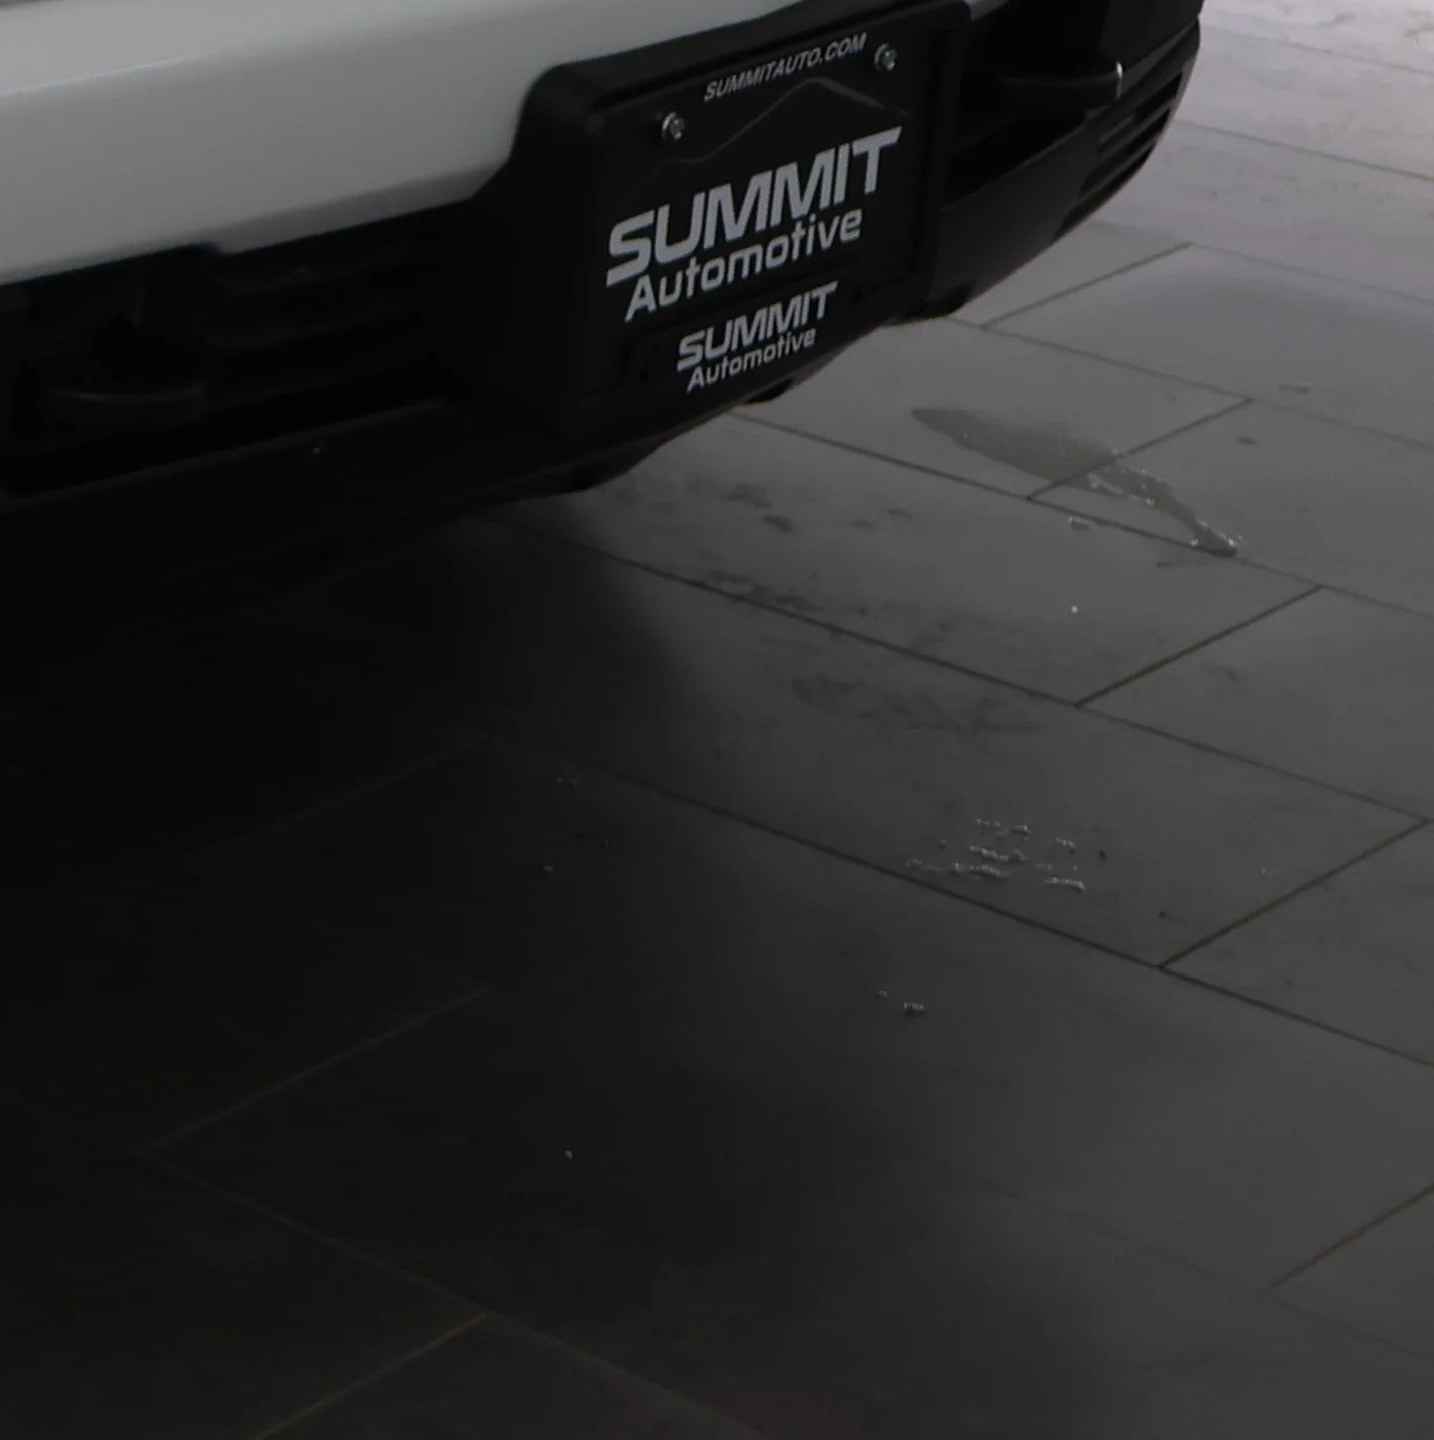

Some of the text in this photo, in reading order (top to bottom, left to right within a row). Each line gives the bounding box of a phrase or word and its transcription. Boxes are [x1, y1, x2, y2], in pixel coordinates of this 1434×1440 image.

[703, 31, 868, 102] SUMMITAUTO.COM
[605, 125, 903, 288] SUMMIT
[623, 207, 863, 323] Automotive
[676, 279, 839, 372] SUMMIT
[685, 327, 817, 394] Automotive
